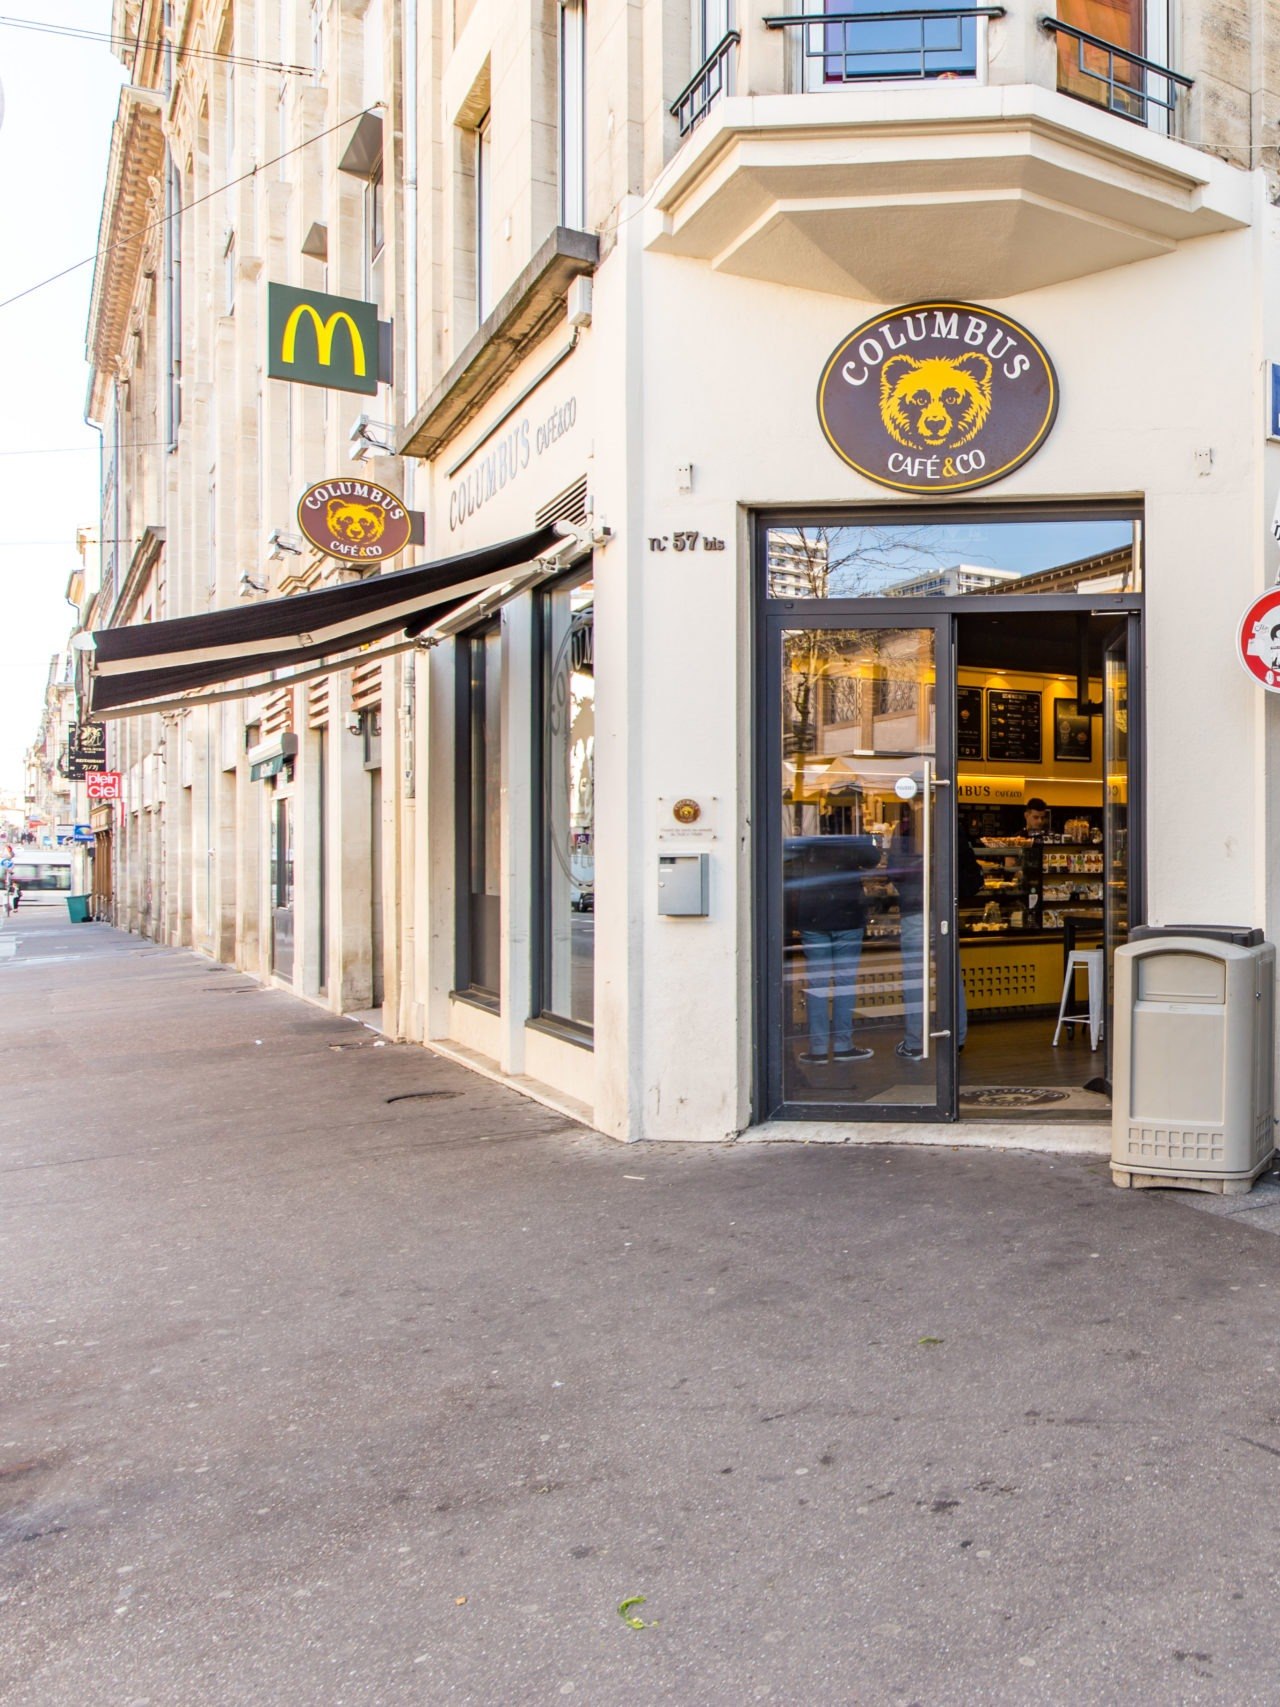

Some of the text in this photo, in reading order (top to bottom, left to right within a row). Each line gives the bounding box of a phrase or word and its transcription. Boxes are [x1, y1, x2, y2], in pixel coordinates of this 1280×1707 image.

[841, 311, 1031, 387] COLUMBUS
[449, 396, 577, 532] COLUMBUS CAFÉ&CO
[305, 482, 404, 519] COLUMBUS
[673, 531, 699, 552] 57
[703, 537, 725, 551] bis
[88, 774, 119, 786] plein
[88, 785, 119, 798] ciel
